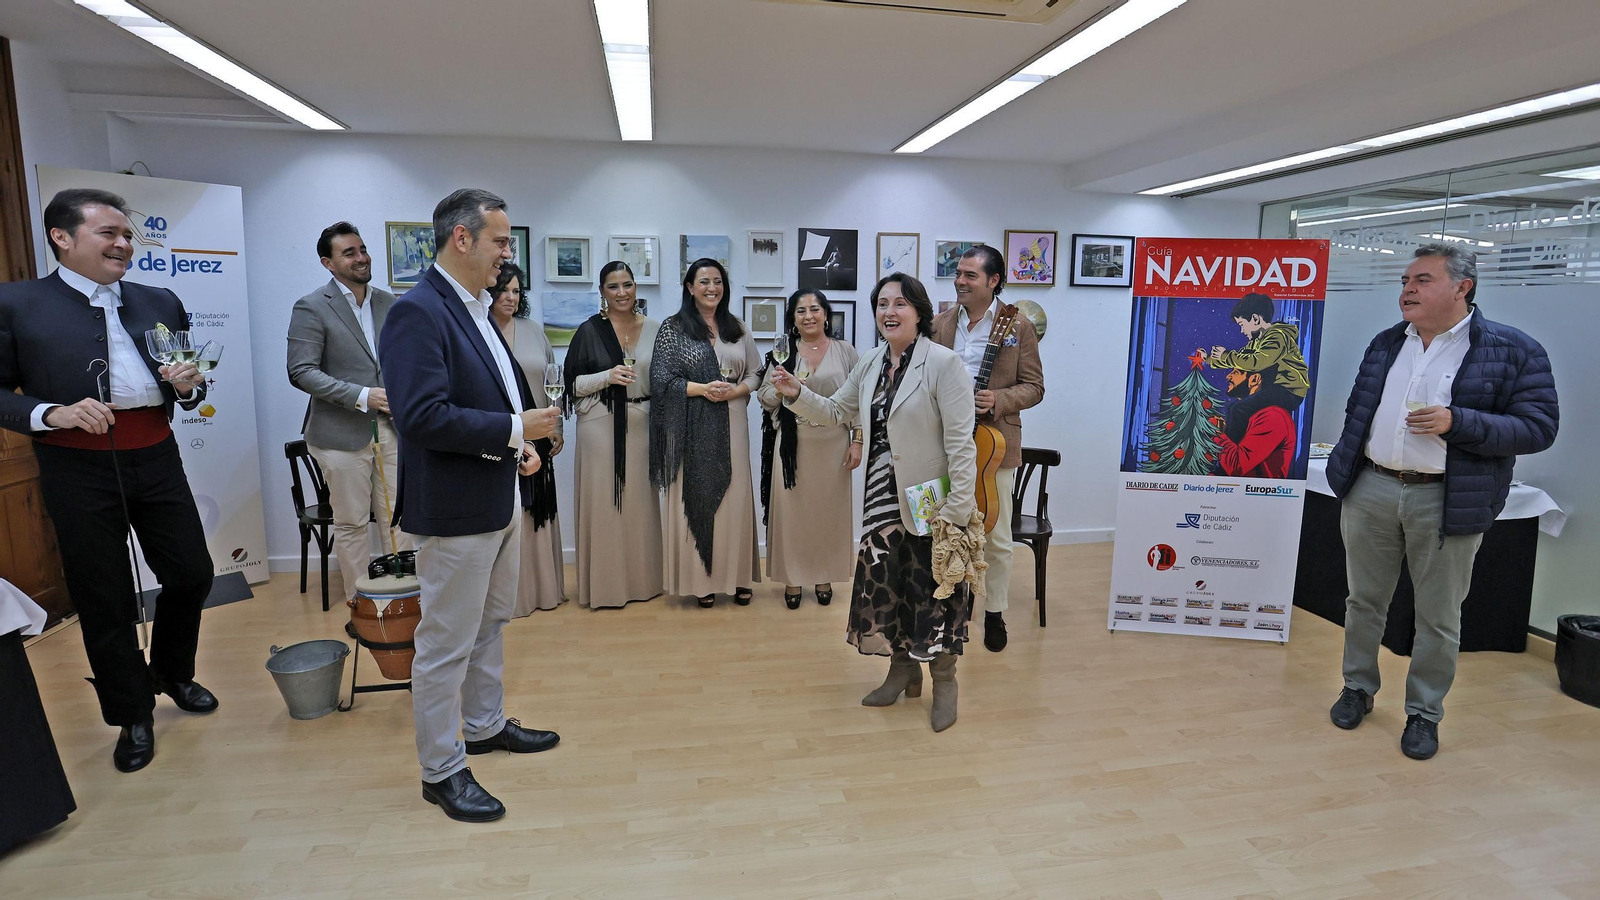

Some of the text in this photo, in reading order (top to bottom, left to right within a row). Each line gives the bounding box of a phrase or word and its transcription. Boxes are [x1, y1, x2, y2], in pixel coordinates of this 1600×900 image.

[144, 216, 167, 231] 40
[1147, 246, 1173, 256] Guía
[138, 251, 166, 271] de
[170, 254, 223, 278] Jerez
[1145, 256, 1317, 287] NAVIDAD
[195, 312, 230, 322] Diputación
[181, 417, 207, 425] indeso
[1126, 481, 1149, 489] DIARIO
[1184, 484, 1204, 492] Diario
[1215, 486, 1234, 494] Jerez
[1245, 484, 1293, 494] EuropaSur
[1203, 514, 1240, 522] Diputación
[1213, 523, 1232, 531] Cádiz
[220, 560, 262, 572] GRUPOJOLY
